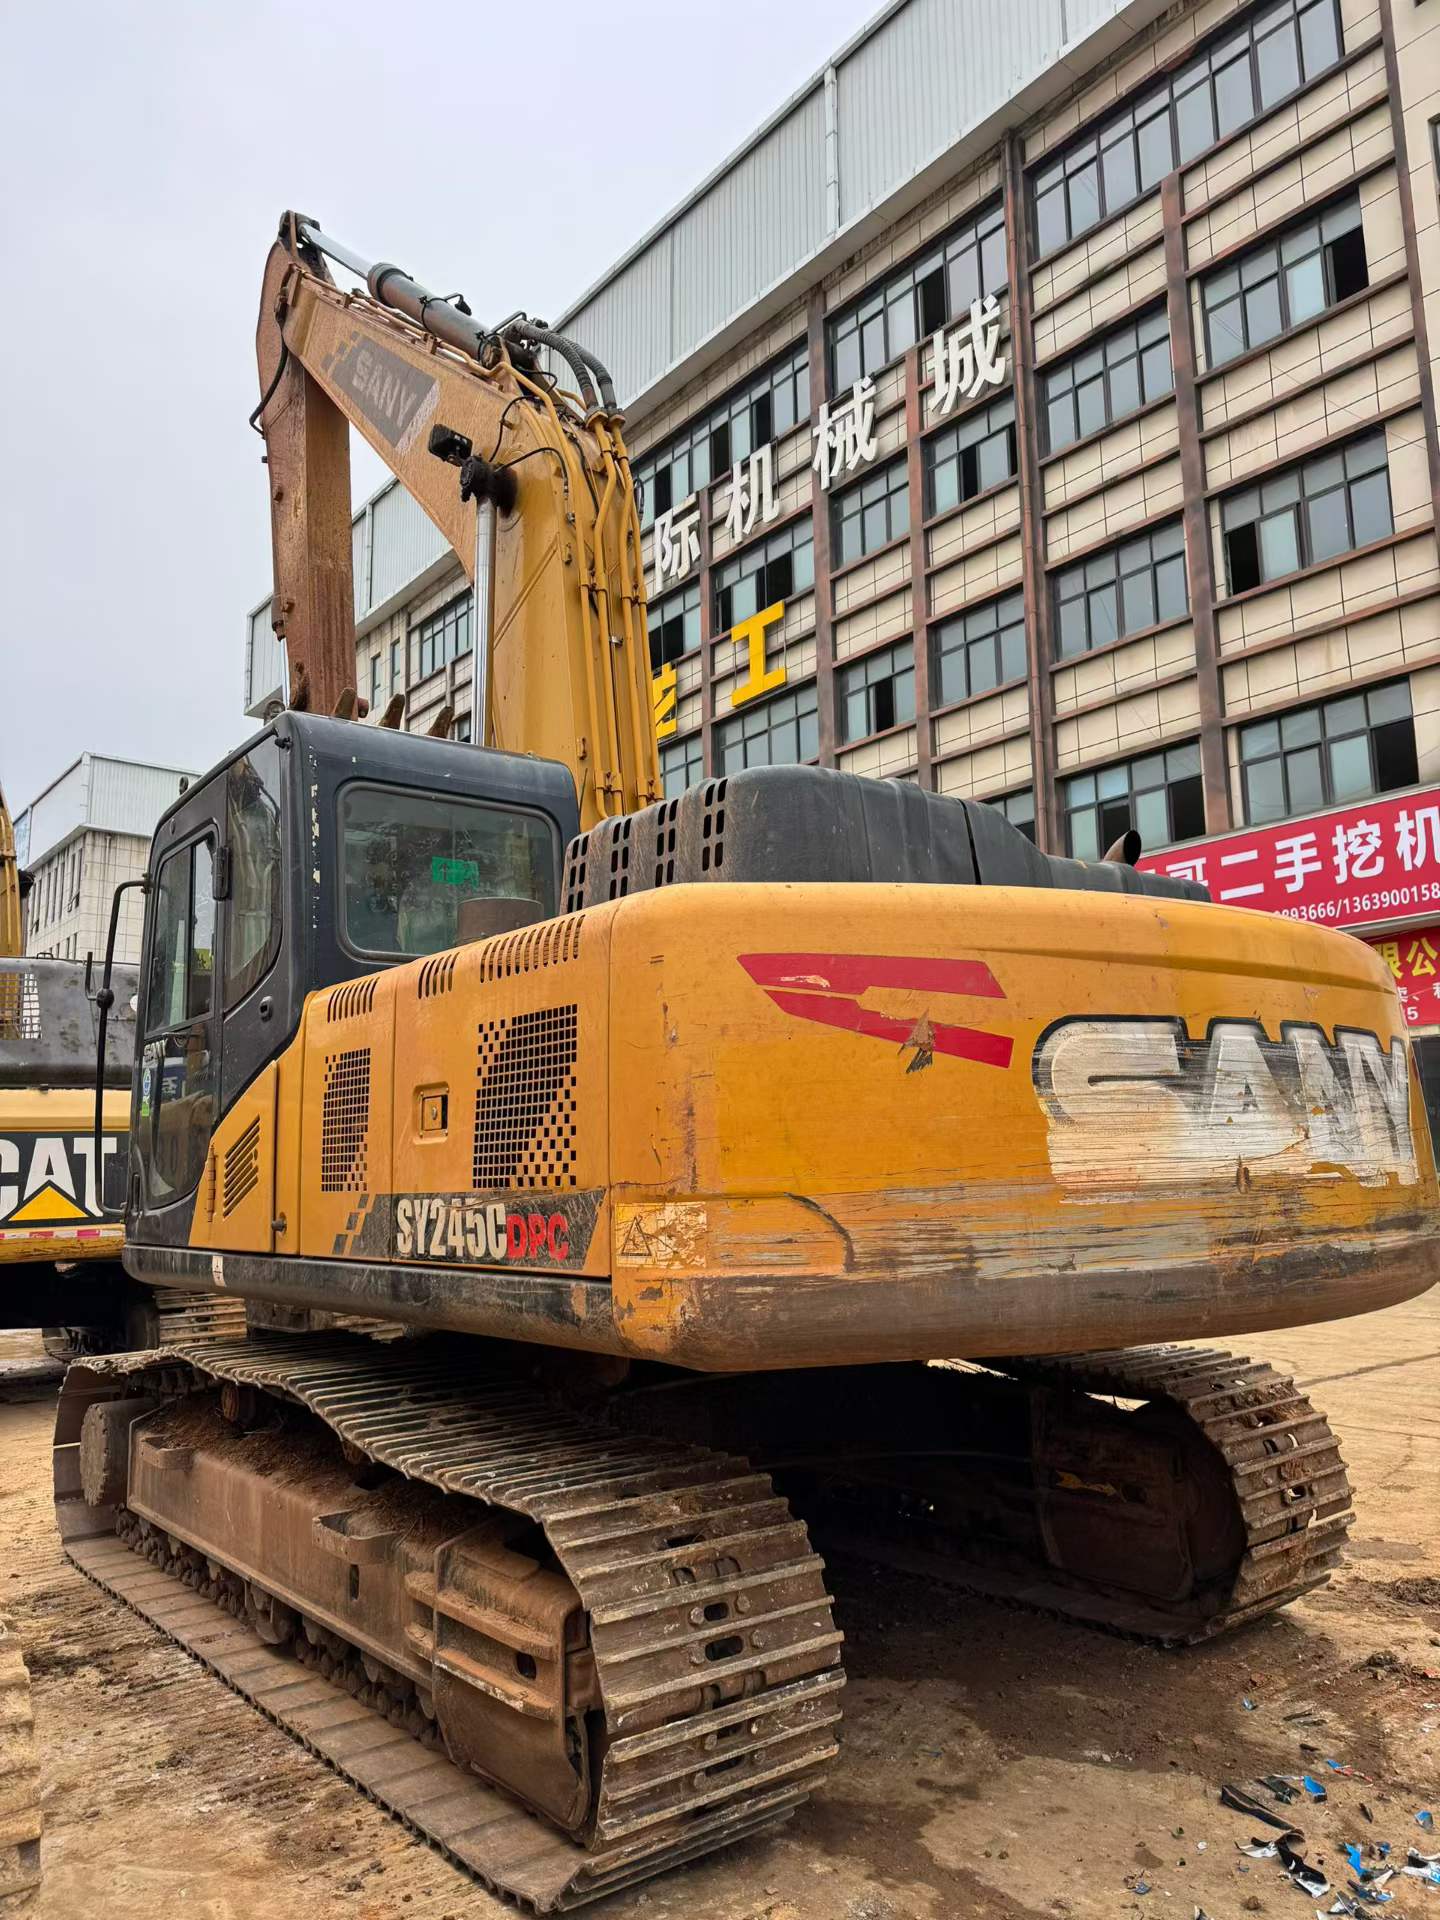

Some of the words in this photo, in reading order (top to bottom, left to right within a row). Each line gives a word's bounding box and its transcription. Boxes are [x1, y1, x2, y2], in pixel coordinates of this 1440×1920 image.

[351, 350, 417, 427] SANY
[654, 294, 1007, 592] 际机械城
[1032, 1014, 1418, 1196] SANY
